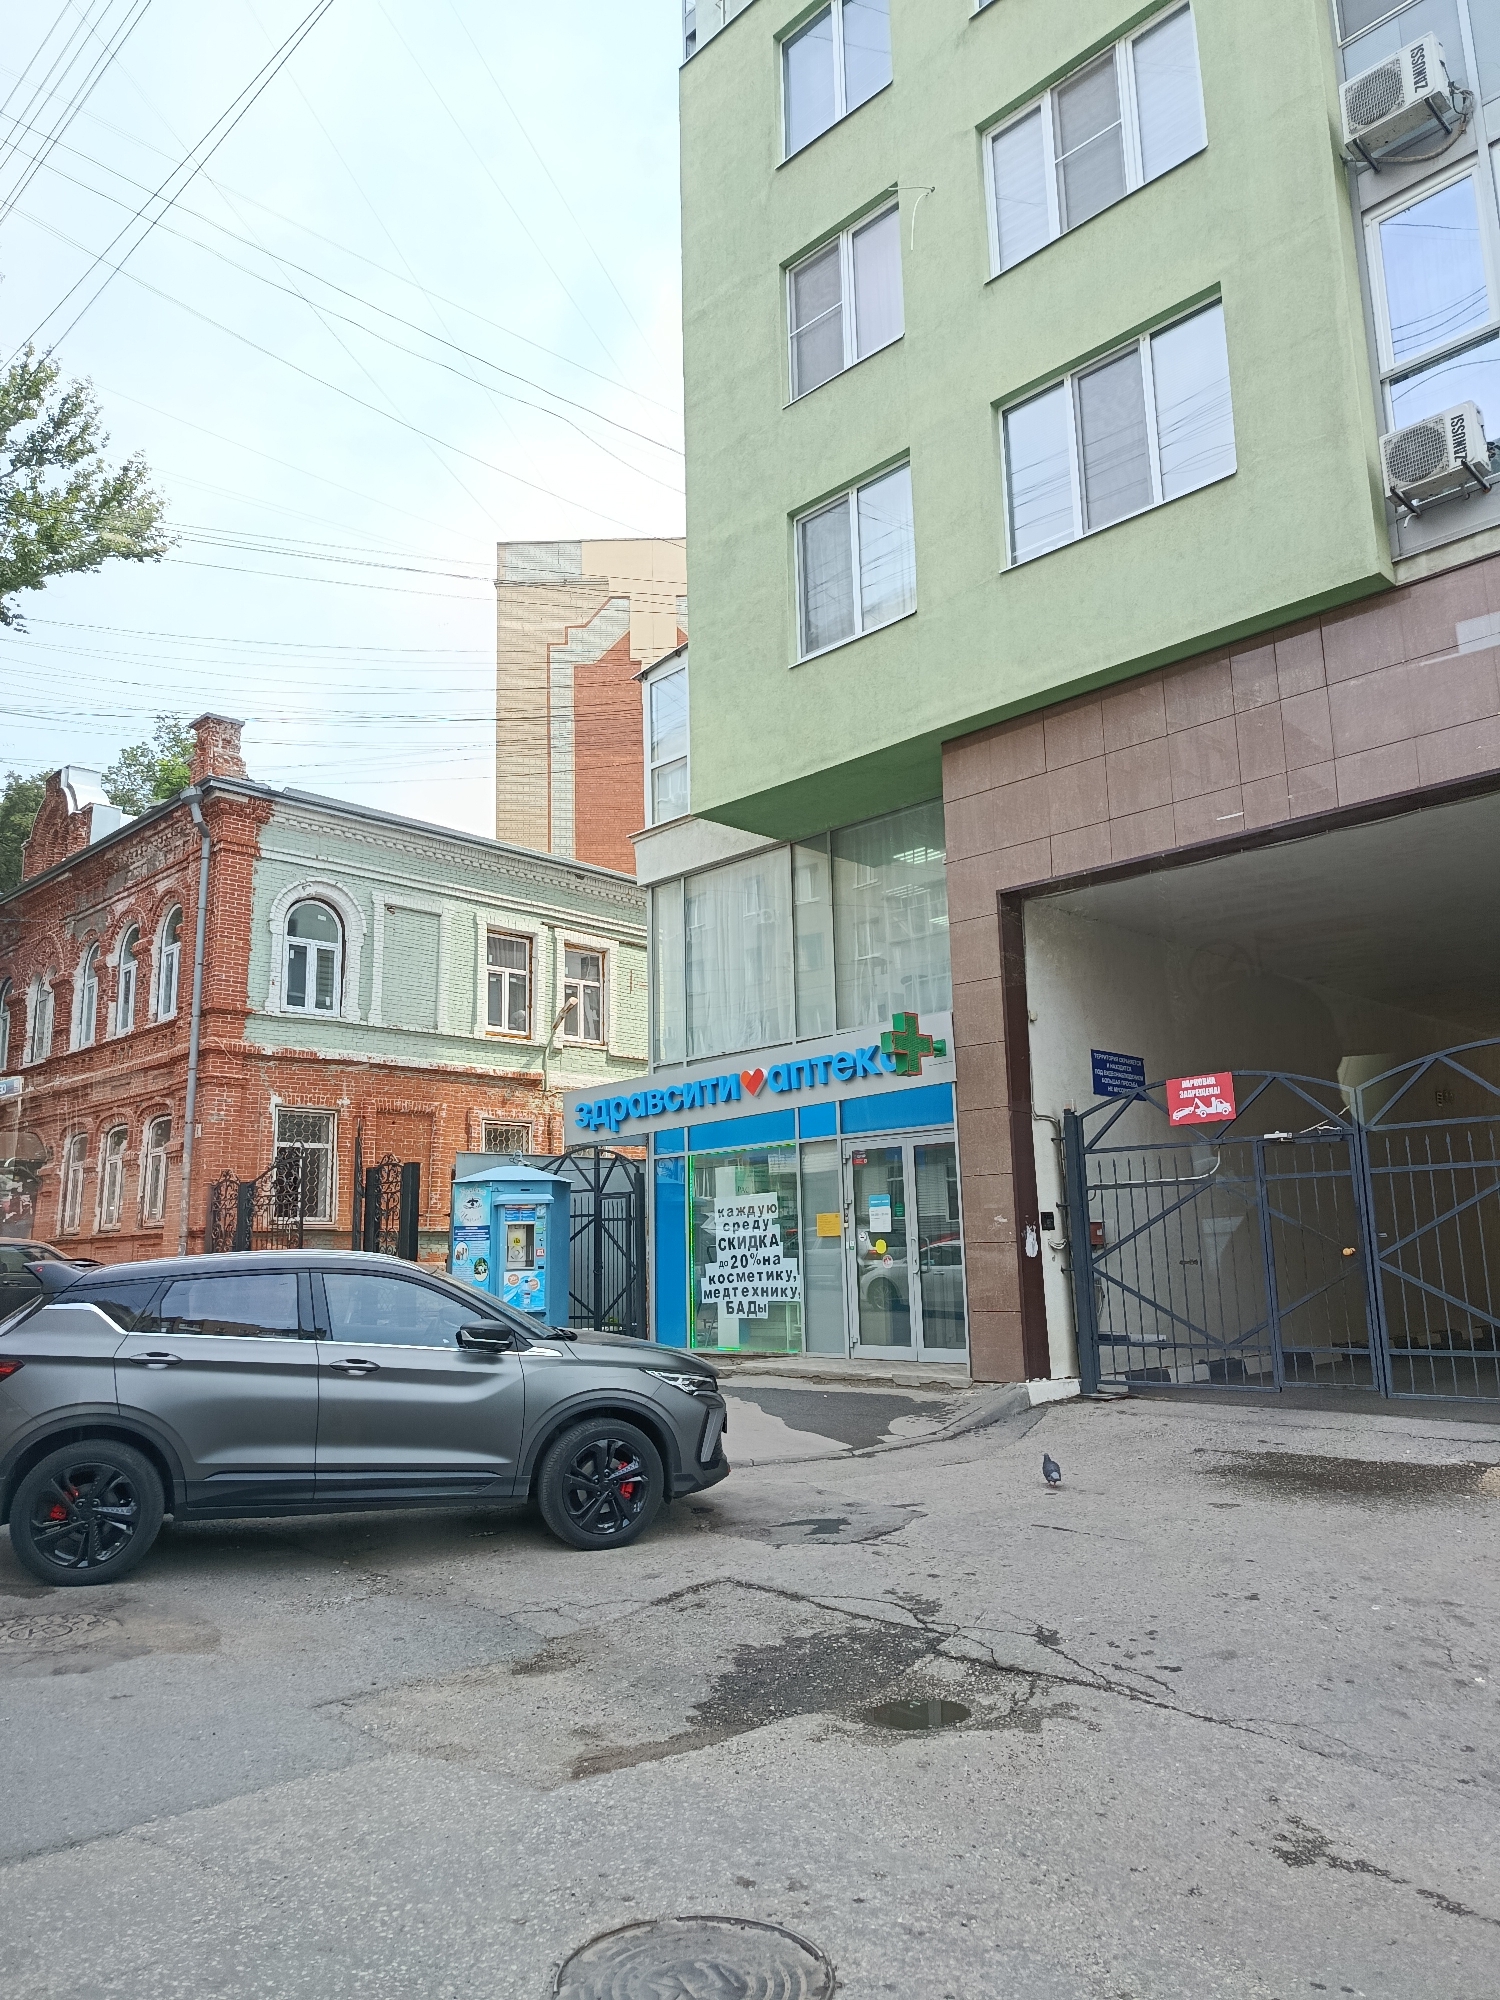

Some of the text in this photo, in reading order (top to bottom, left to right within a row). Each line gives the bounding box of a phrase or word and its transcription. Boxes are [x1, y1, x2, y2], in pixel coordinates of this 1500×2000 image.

[1410, 43, 1429, 94] ZANUSSI
[1450, 413, 1468, 463] ZANUSSI
[1182, 1077, 1216, 1088] ПАРКОВКА
[1179, 1086, 1220, 1098] ЗАПРЕЩЕНА!
[575, 1073, 742, 1132] здравсити
[717, 1203, 778, 1219] каждую
[722, 1218, 770, 1234] среду
[718, 1233, 780, 1251] СКИДКА
[718, 1260, 729, 1269] до
[708, 1269, 797, 1285] косметику,
[703, 1286, 801, 1300] медтехнику,
[725, 1300, 767, 1318] БАДы
